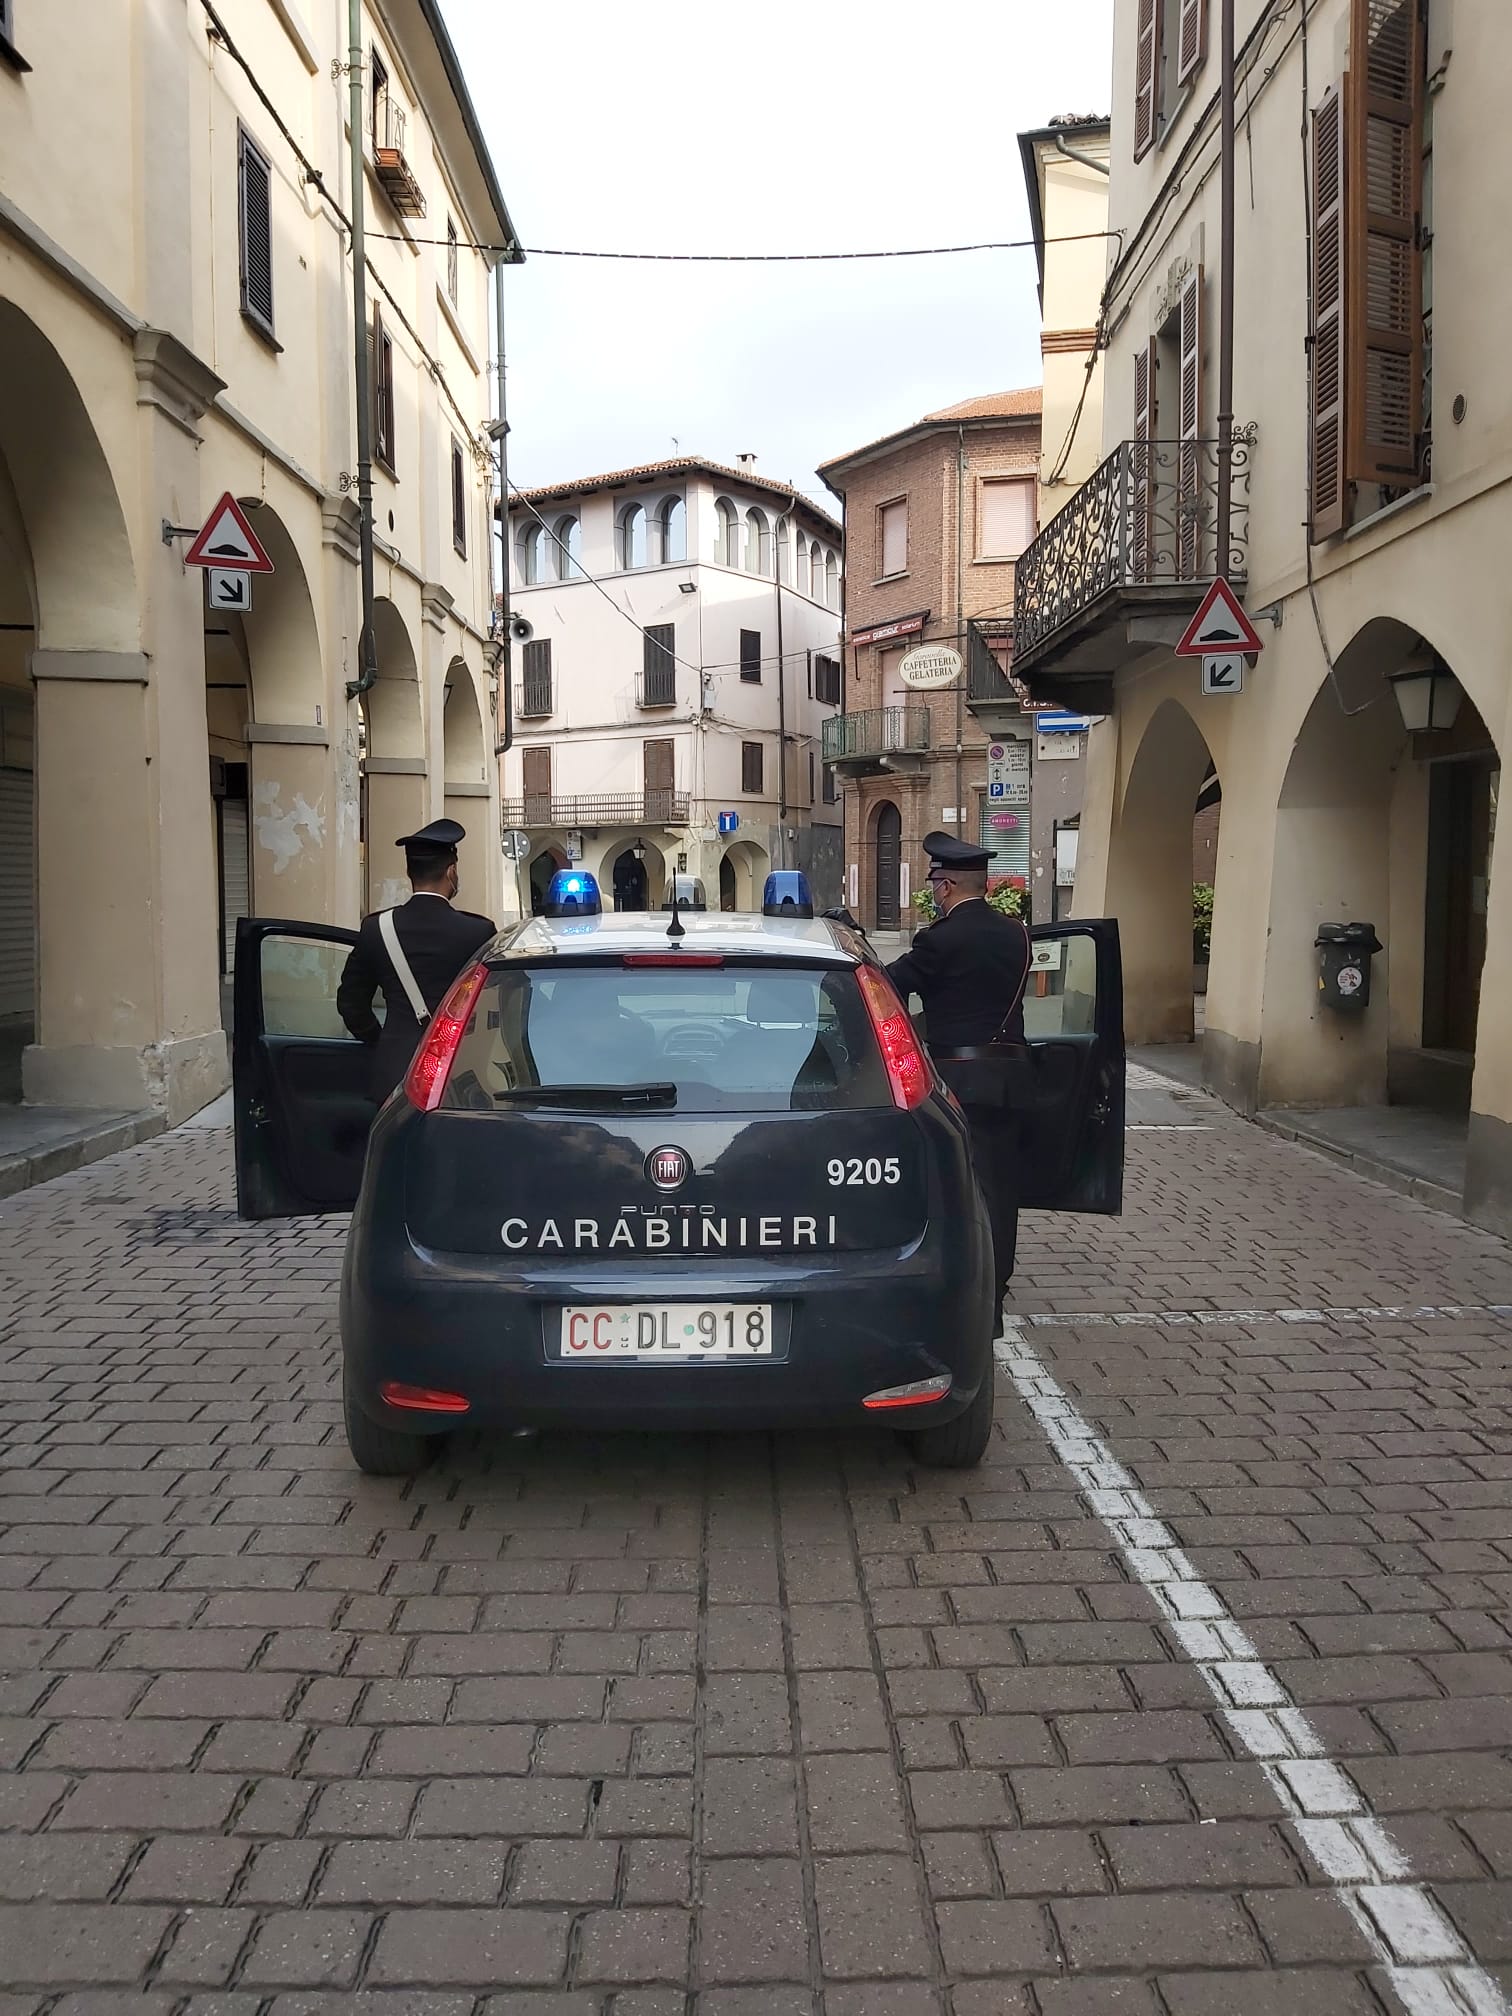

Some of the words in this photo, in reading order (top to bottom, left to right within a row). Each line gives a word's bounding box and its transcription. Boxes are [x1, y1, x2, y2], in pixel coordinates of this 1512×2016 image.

[903, 656, 957, 671] CAFFETTERIA
[909, 667, 953, 681] GELATERIA
[658, 1160, 681, 1178] FIAT
[827, 1157, 901, 1186] 9205
[620, 1205, 716, 1216] PUNTO
[500, 1215, 836, 1249] CARABINIERI
[569, 1312, 612, 1350] CC
[638, 1311, 681, 1349] DL
[698, 1310, 765, 1349] 918
